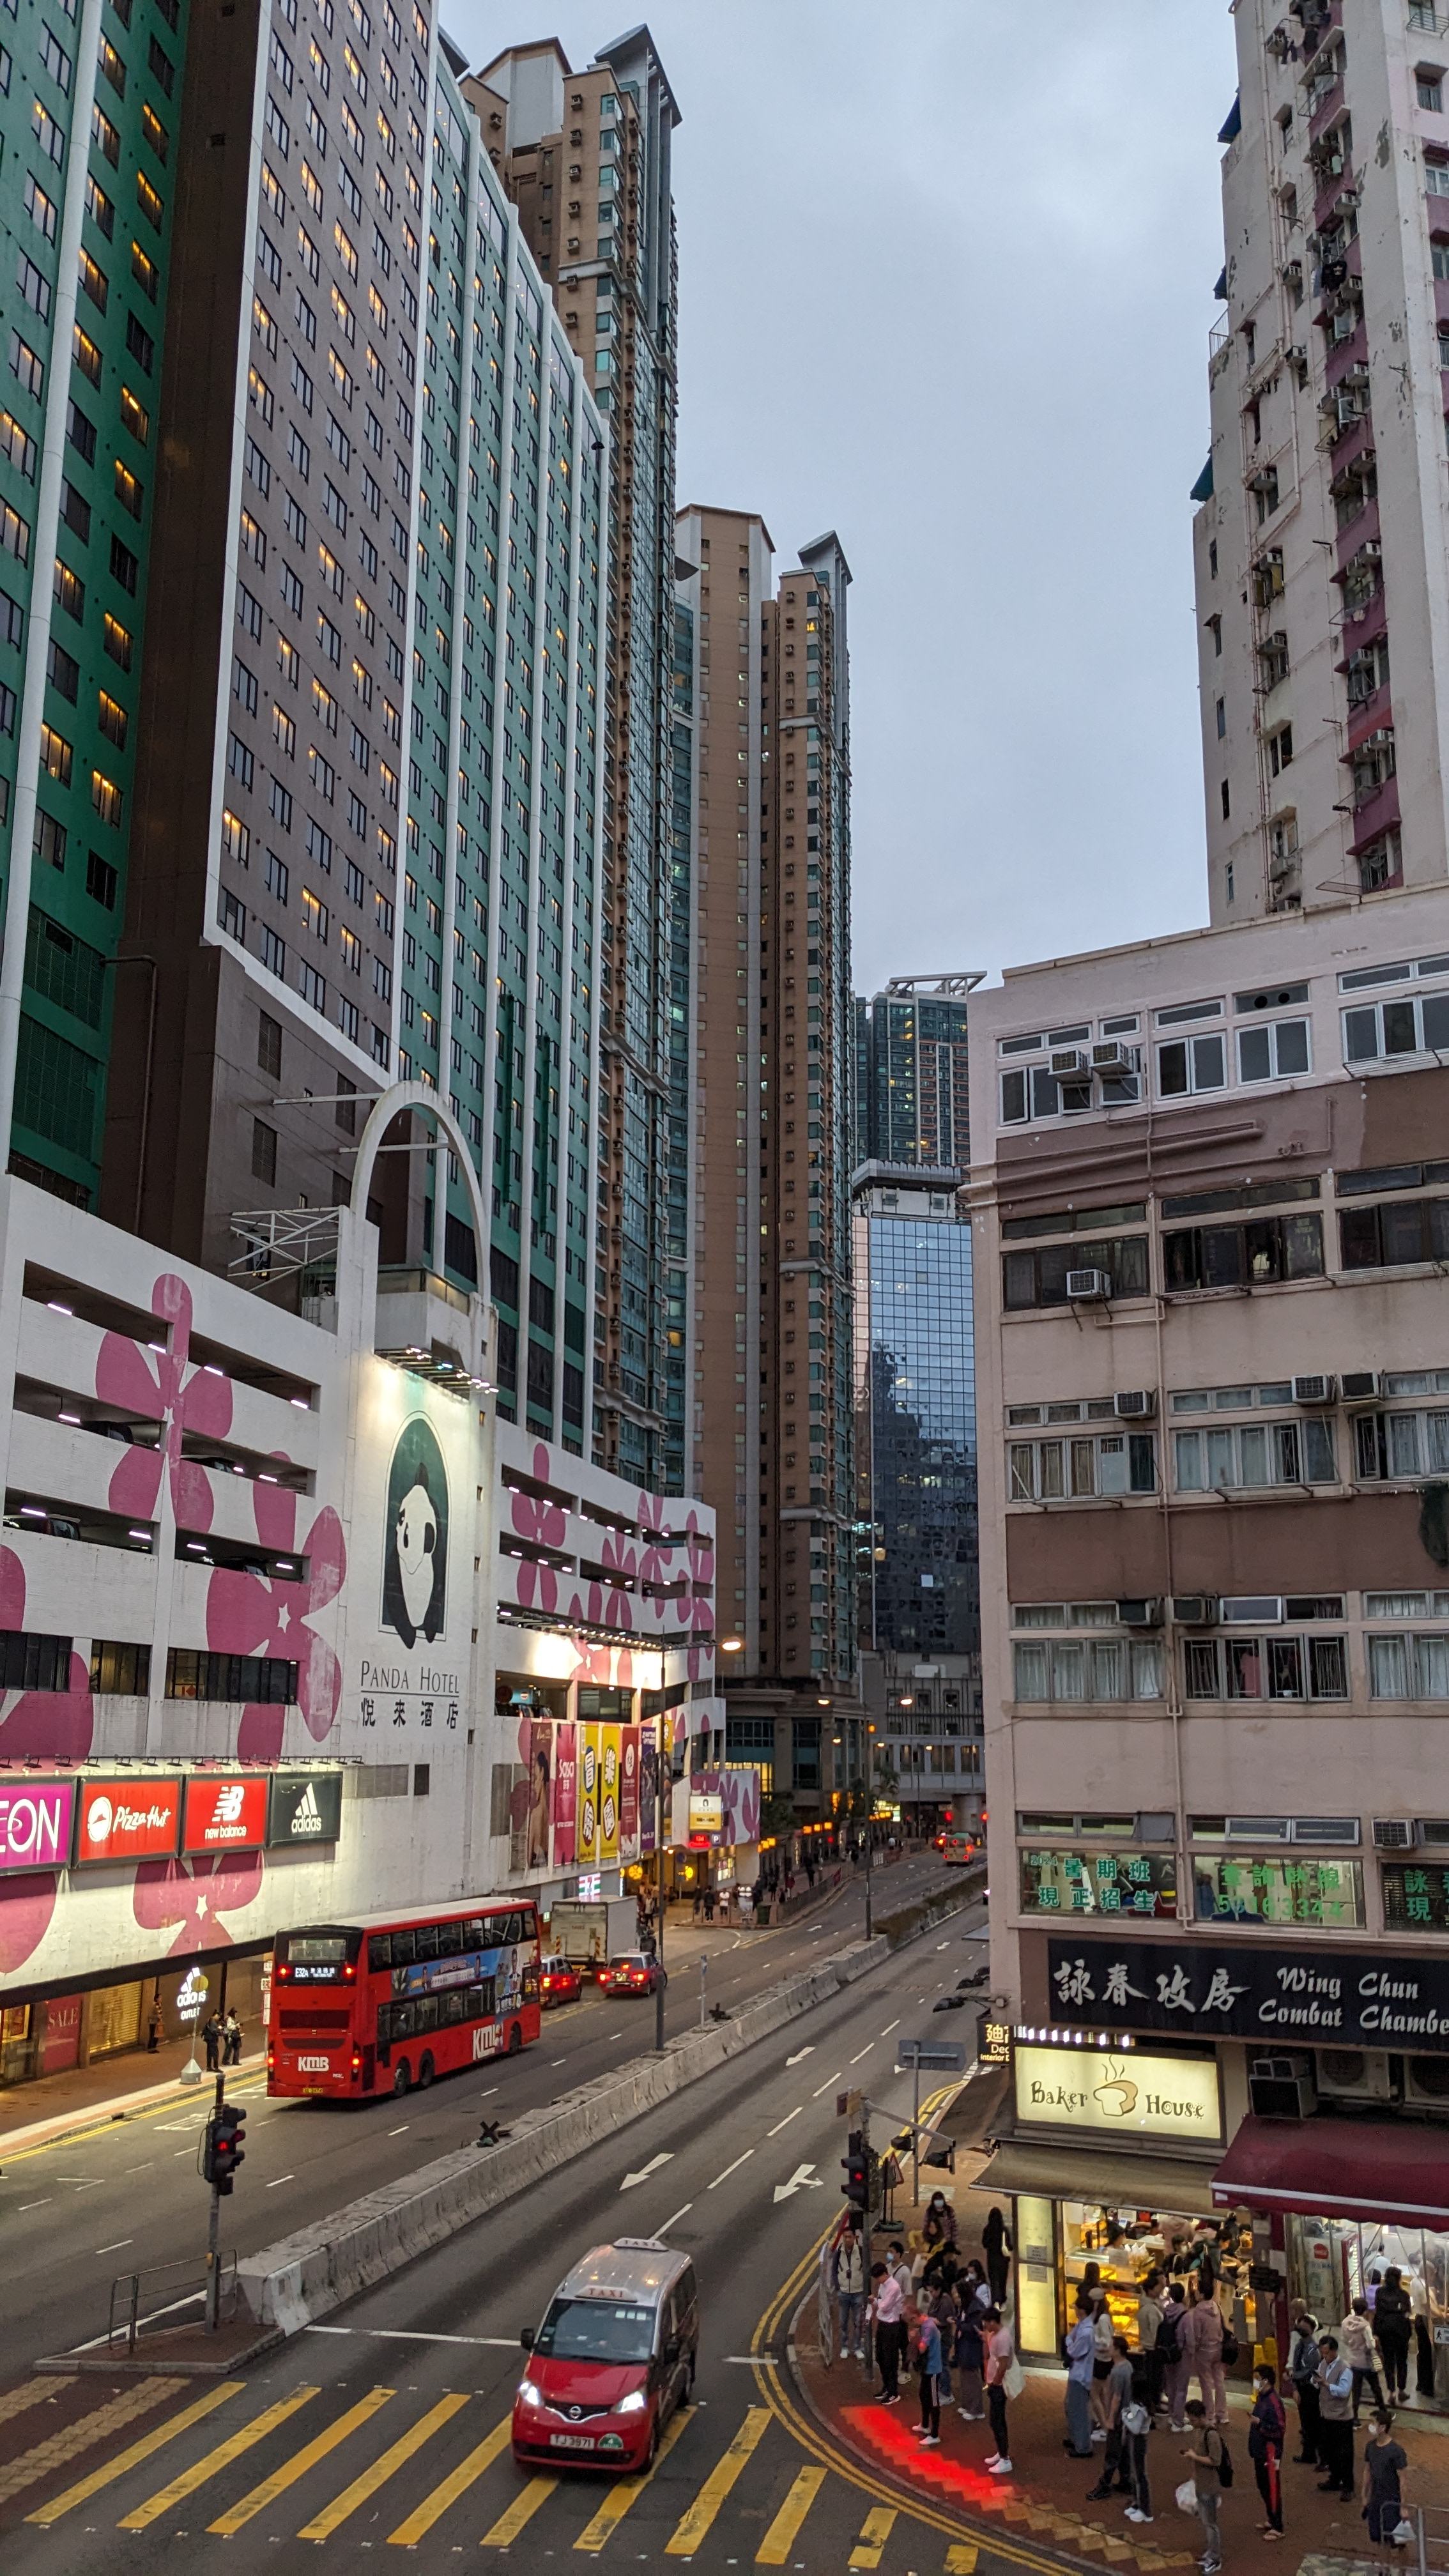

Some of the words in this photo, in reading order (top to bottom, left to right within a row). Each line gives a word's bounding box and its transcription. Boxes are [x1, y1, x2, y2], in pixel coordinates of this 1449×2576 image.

[360, 1660, 409, 1689] PANDA
[420, 1666, 459, 1694] HOTEL
[361, 1698, 459, 1729] 悅來酒店
[112, 1805, 146, 1833] Pizza
[147, 1805, 171, 1829] Hut
[205, 1827, 218, 1839] new
[219, 1824, 247, 1837] balance
[291, 1814, 321, 1833] adidas
[1064, 1858, 1150, 1882] 暑期班
[1038, 1886, 1155, 1912] 現正招生
[1277, 1966, 1340, 2000] Wing
[1358, 1972, 1419, 1999] Chun
[48, 2007, 79, 2030] SALE
[1259, 1998, 1342, 2027] Combat
[298, 2057, 329, 2071] KMB
[1031, 2080, 1088, 2113] Baker
[1146, 2094, 1205, 2120] House
[588, 2288, 623, 2297] TAXI
